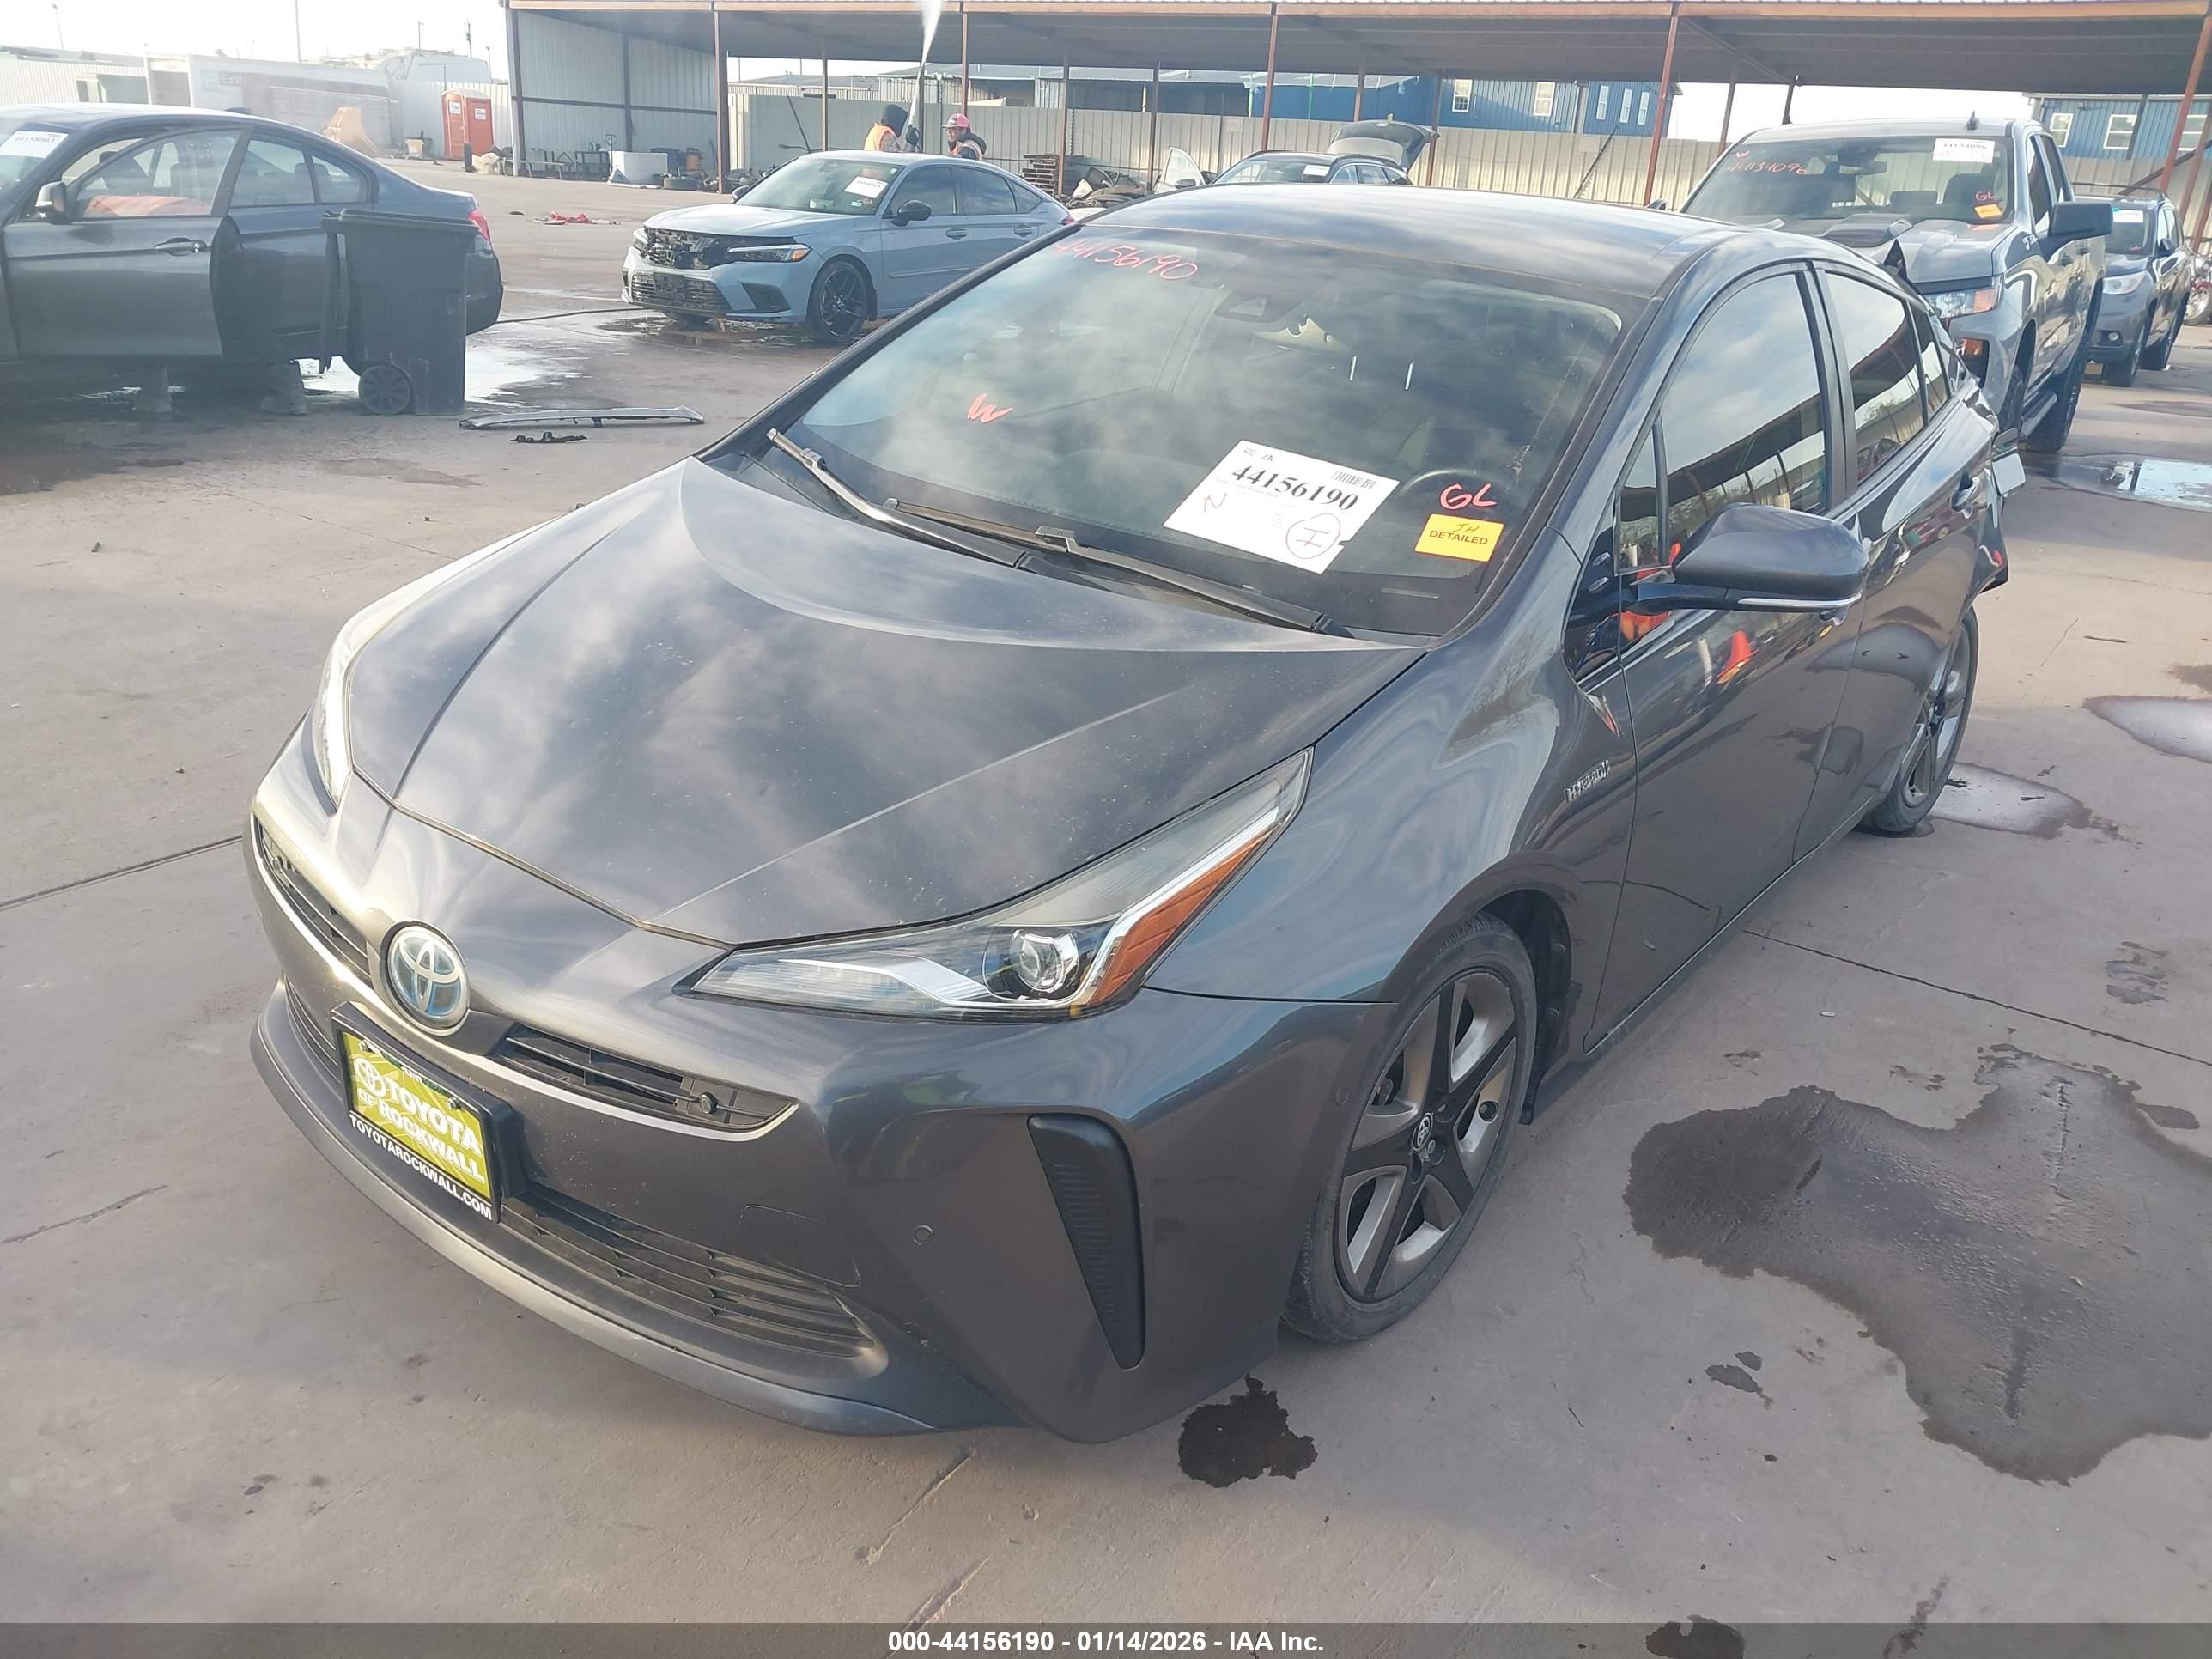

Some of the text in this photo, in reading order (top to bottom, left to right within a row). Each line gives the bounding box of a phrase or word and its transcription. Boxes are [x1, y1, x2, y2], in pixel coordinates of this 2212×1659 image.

[1054, 239, 1199, 280] 44156190
[1231, 465, 1359, 512] 44156190
[1439, 483, 1499, 511] GL
[1428, 529, 1489, 546] DETAILED
[356, 1087, 486, 1183] OF ROCKWALL
[385, 1077, 483, 1158] TOYOTA
[349, 1115, 494, 1221] TOYOTAROCKWALL.COM
